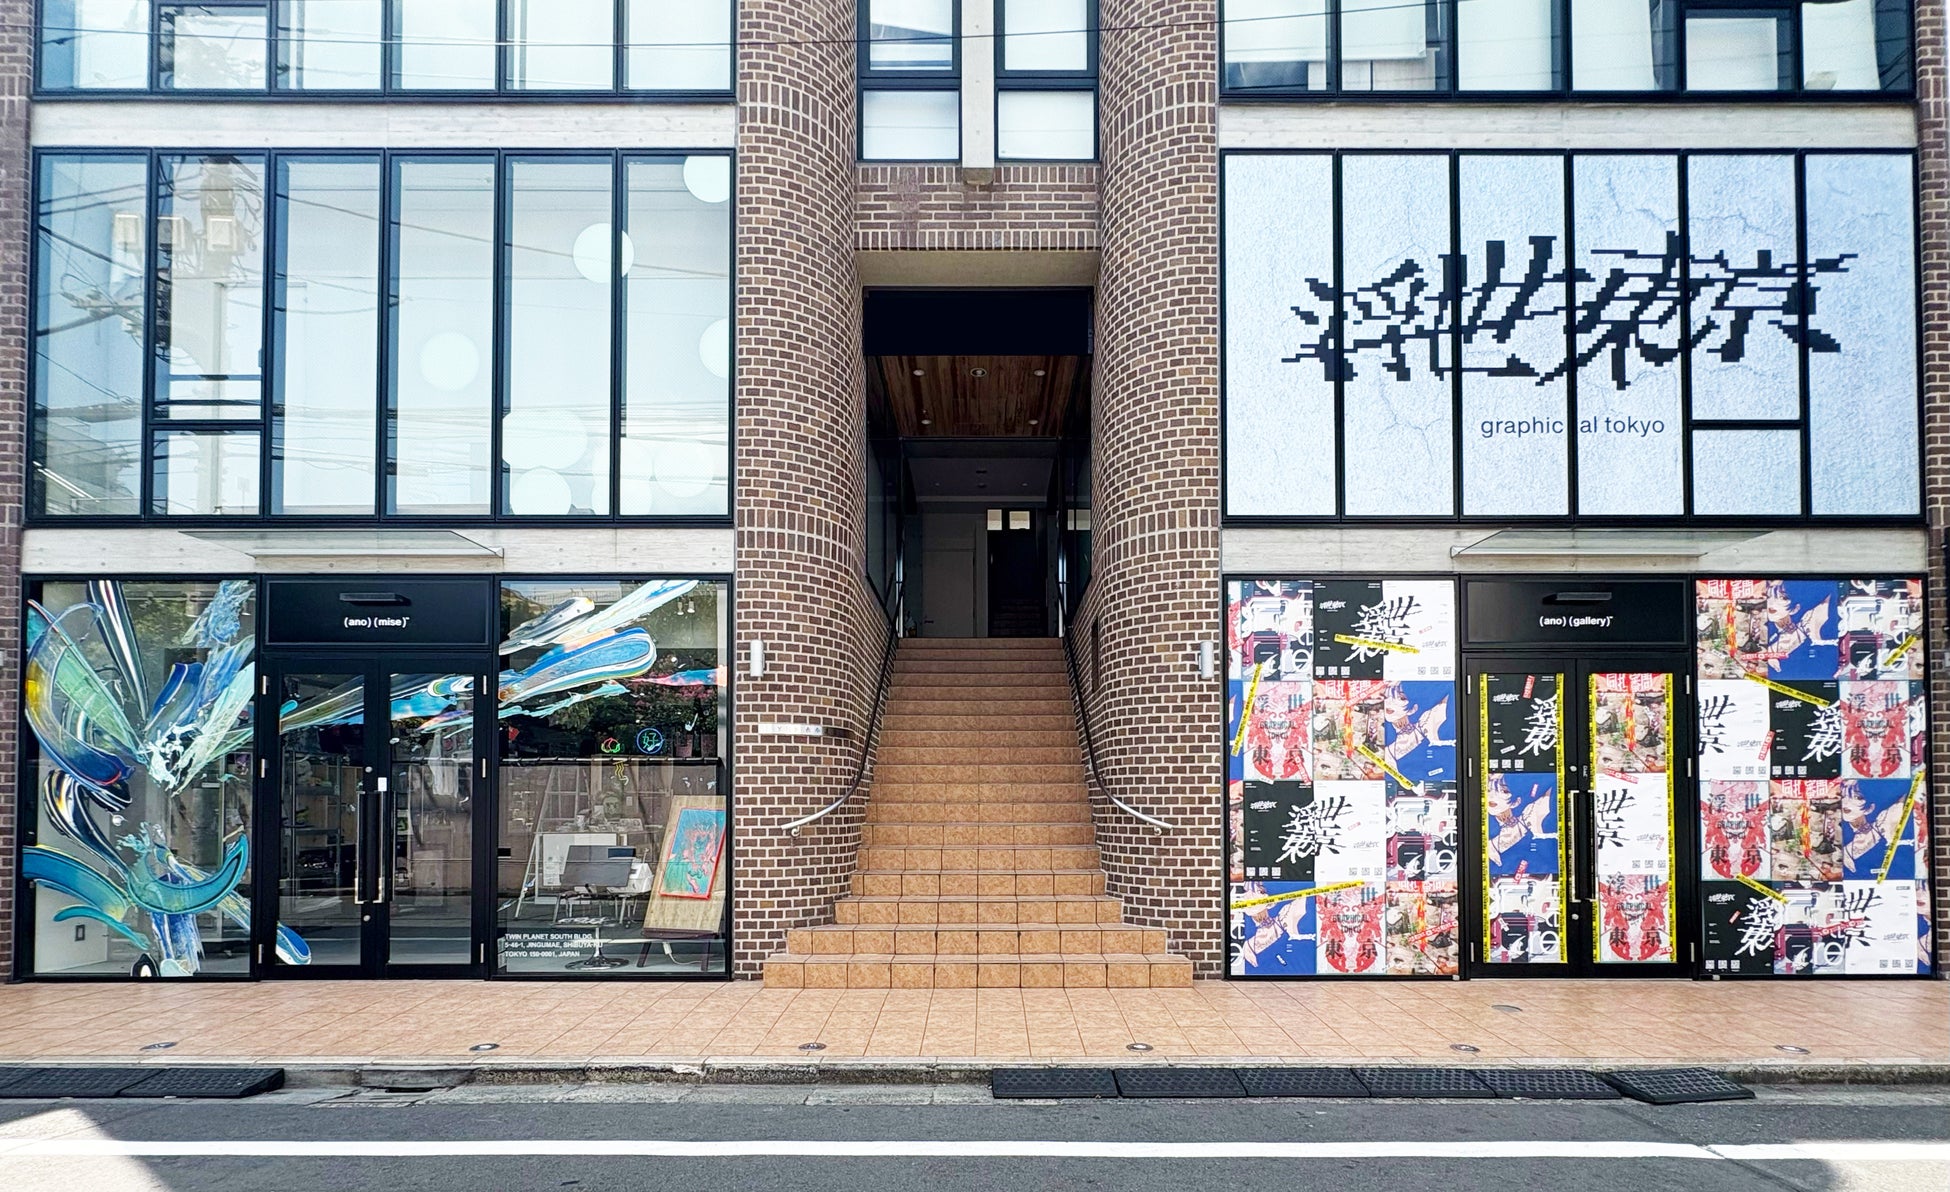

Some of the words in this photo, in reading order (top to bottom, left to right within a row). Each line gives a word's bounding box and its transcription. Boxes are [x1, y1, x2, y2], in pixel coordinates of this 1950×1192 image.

[1604, 415, 1665, 437] tokyo
[344, 616, 372, 628] (ano)
[1539, 616, 1567, 627] (ano)
